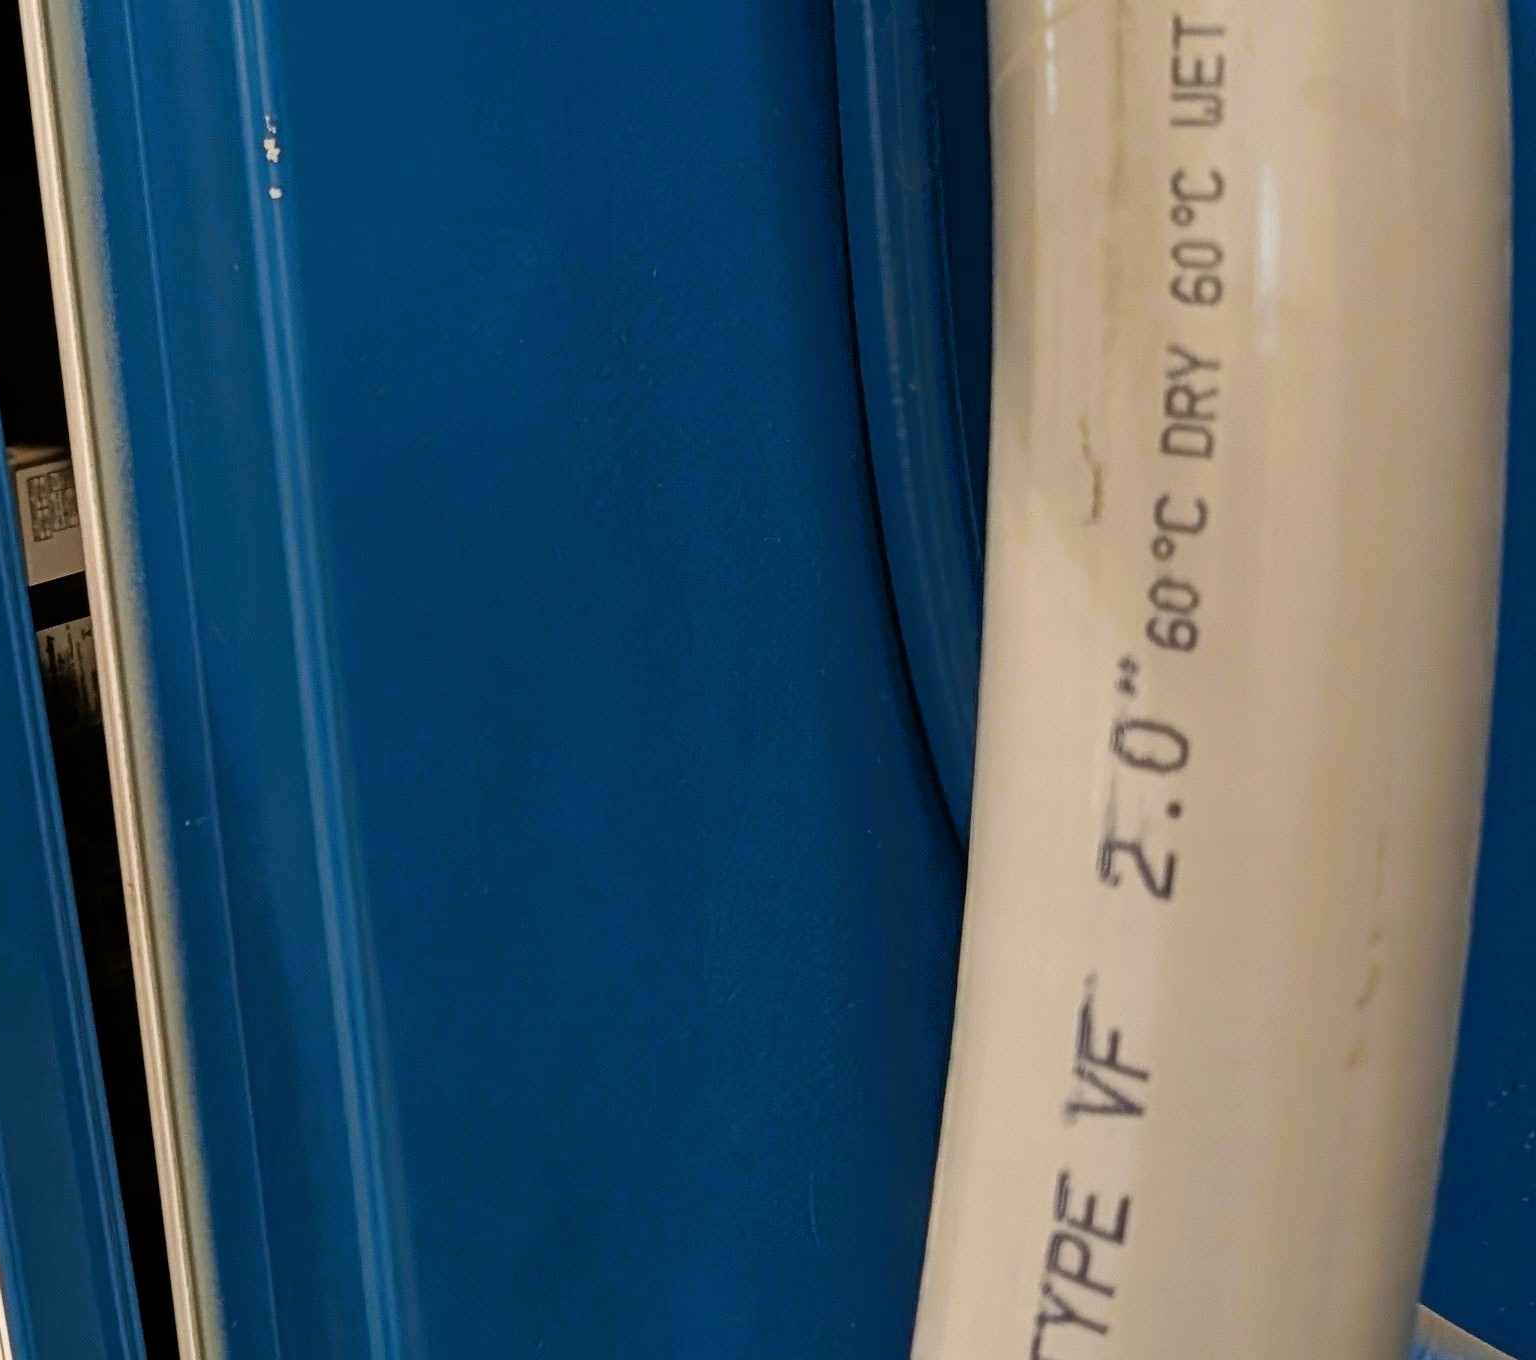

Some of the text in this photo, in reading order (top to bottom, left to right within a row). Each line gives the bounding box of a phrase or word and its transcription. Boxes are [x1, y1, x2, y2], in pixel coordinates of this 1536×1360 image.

[1170, 14, 1227, 129] WET
[1170, 166, 1224, 306] 60°C
[1160, 345, 1221, 460] DRY
[1147, 494, 1207, 654] 60°C
[1062, 975, 1151, 1120] VF
